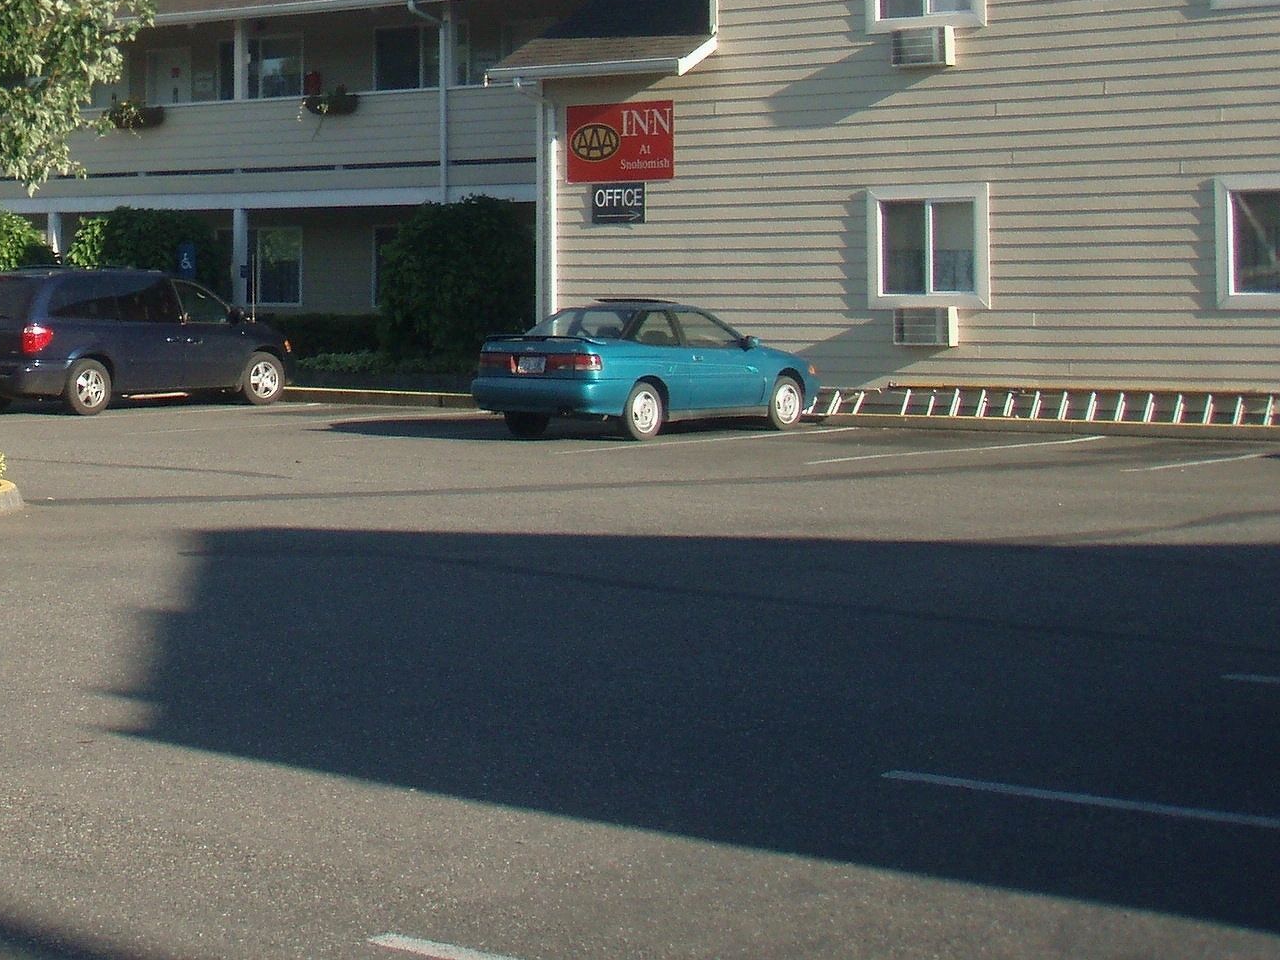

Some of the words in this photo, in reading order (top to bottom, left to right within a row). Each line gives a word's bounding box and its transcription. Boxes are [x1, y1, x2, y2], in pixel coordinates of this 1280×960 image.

[576, 126, 614, 158] AAA
[639, 145, 651, 154] At
[620, 158, 670, 171] Snohomish
[595, 188, 643, 207] OFFICE
